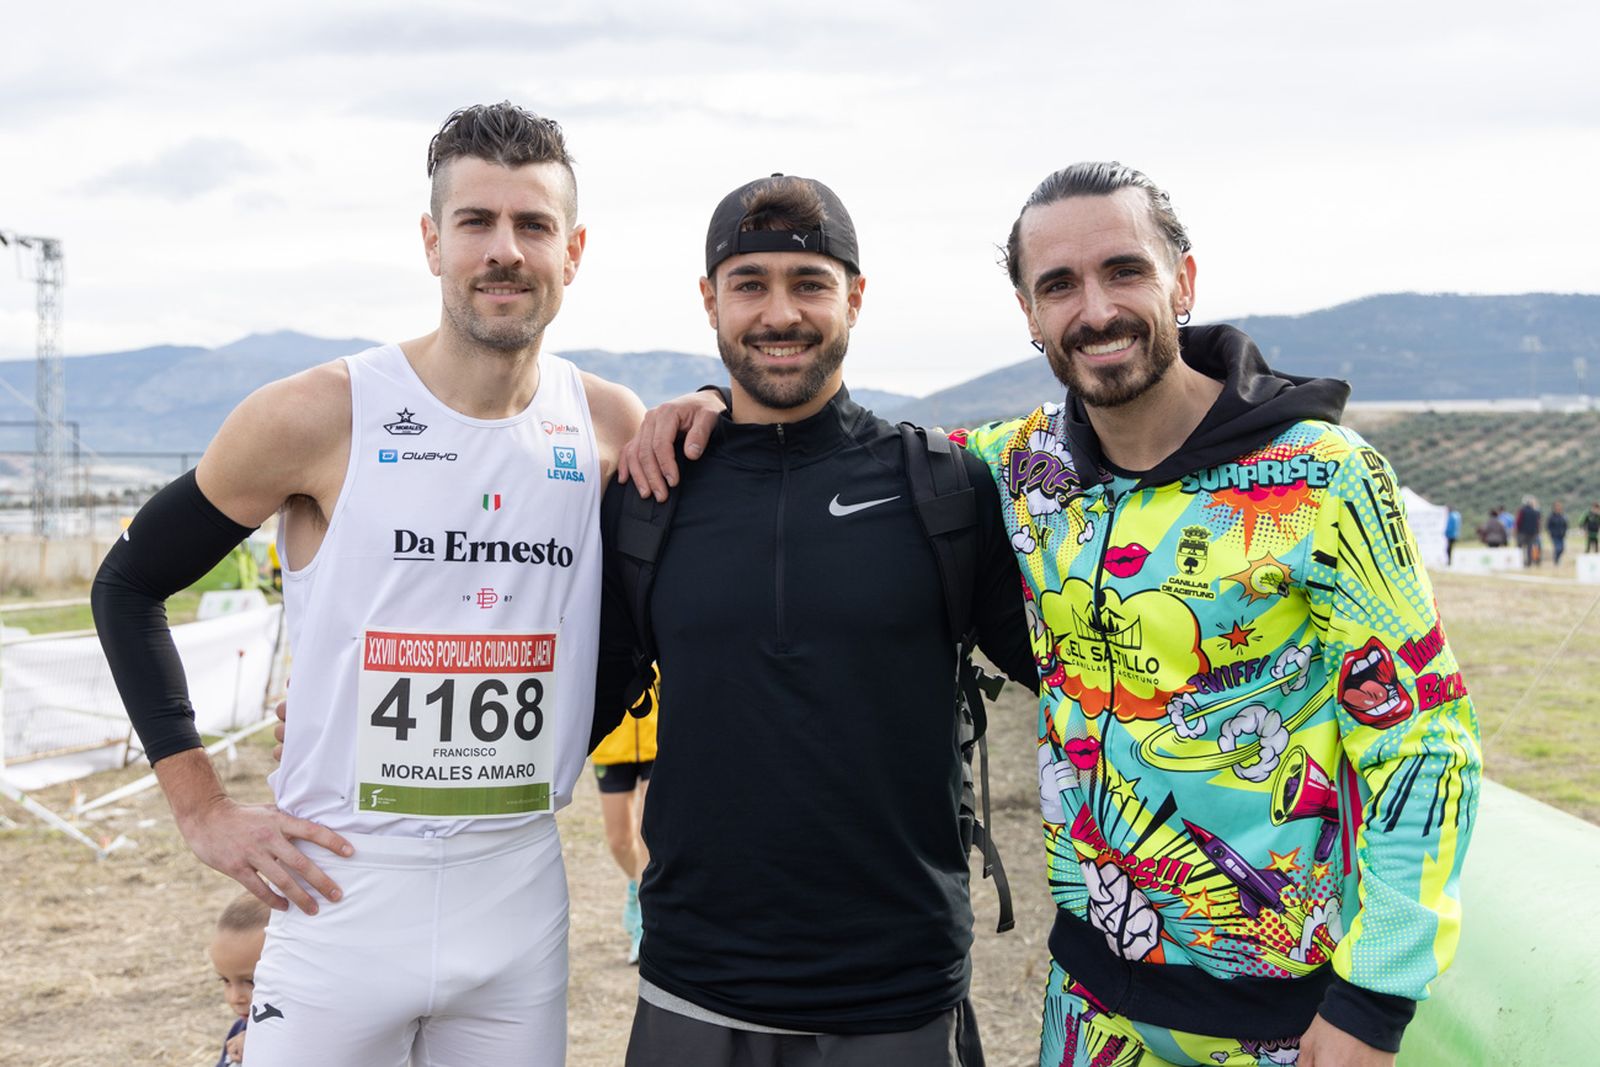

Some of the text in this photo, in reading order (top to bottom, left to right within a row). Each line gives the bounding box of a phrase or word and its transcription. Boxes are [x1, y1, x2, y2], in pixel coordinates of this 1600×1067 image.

[547, 468, 586, 483] LEVASA
[1180, 453, 1340, 495] SURPRISE!
[393, 529, 574, 568] Da Ernesto
[1162, 584, 1215, 599] DE ACEITUNO
[1168, 577, 1209, 589] CANILLAS
[367, 636, 397, 665] XXVIII
[398, 638, 434, 667] CROSS
[436, 639, 482, 667] POPULAR
[484, 639, 519, 668] CIUDAD
[520, 640, 532, 667] DE
[1069, 640, 1086, 660] EL
[1071, 659, 1107, 673] CANILLAS
[1118, 670, 1160, 685] ACEITUNO
[370, 677, 544, 743] 4168
[433, 747, 497, 758] FRANCISCO
[381, 762, 536, 781] MORALES AMARO
